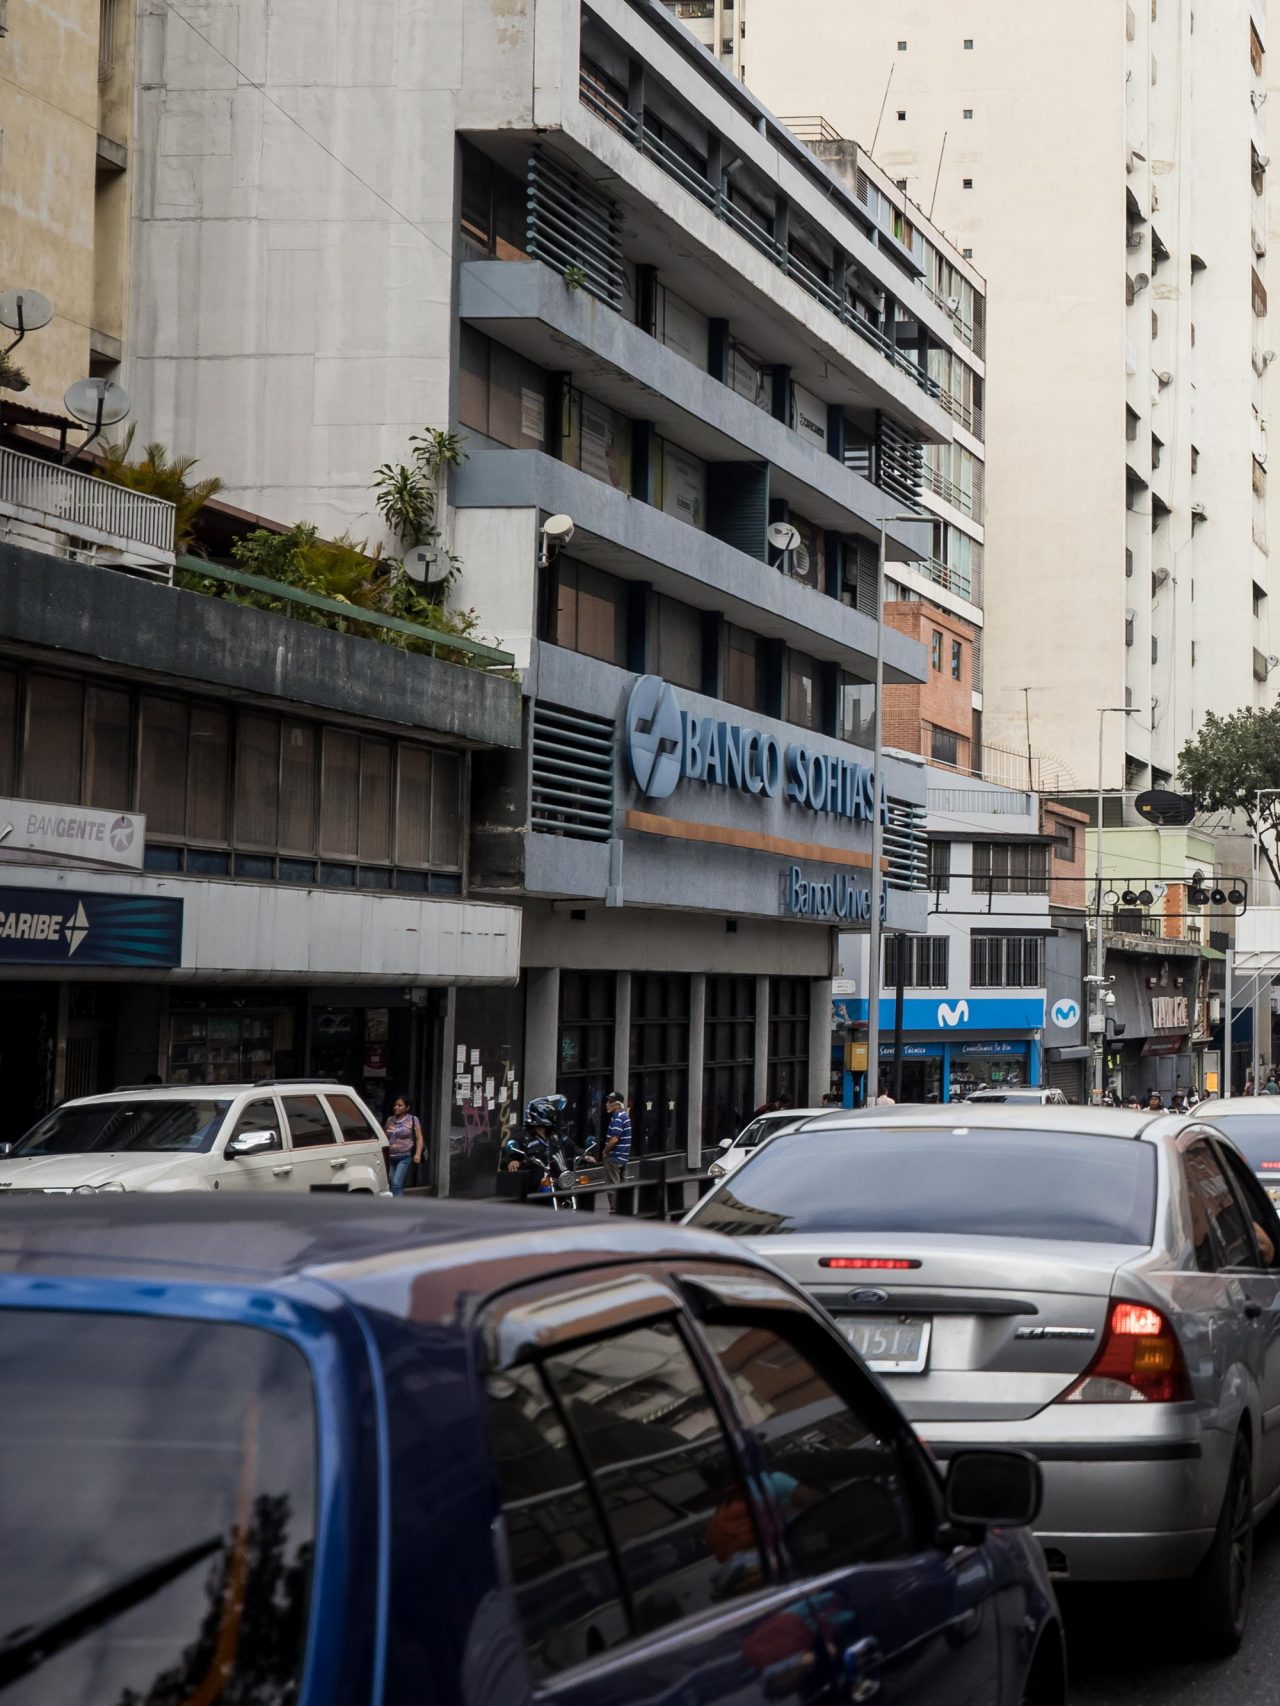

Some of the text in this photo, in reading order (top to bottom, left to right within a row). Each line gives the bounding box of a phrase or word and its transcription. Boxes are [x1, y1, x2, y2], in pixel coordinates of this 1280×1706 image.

[680, 711, 889, 826] BANCO SOFITASA
[27, 814, 106, 841] BANGENTE
[788, 866, 888, 922] Banco Univeal
